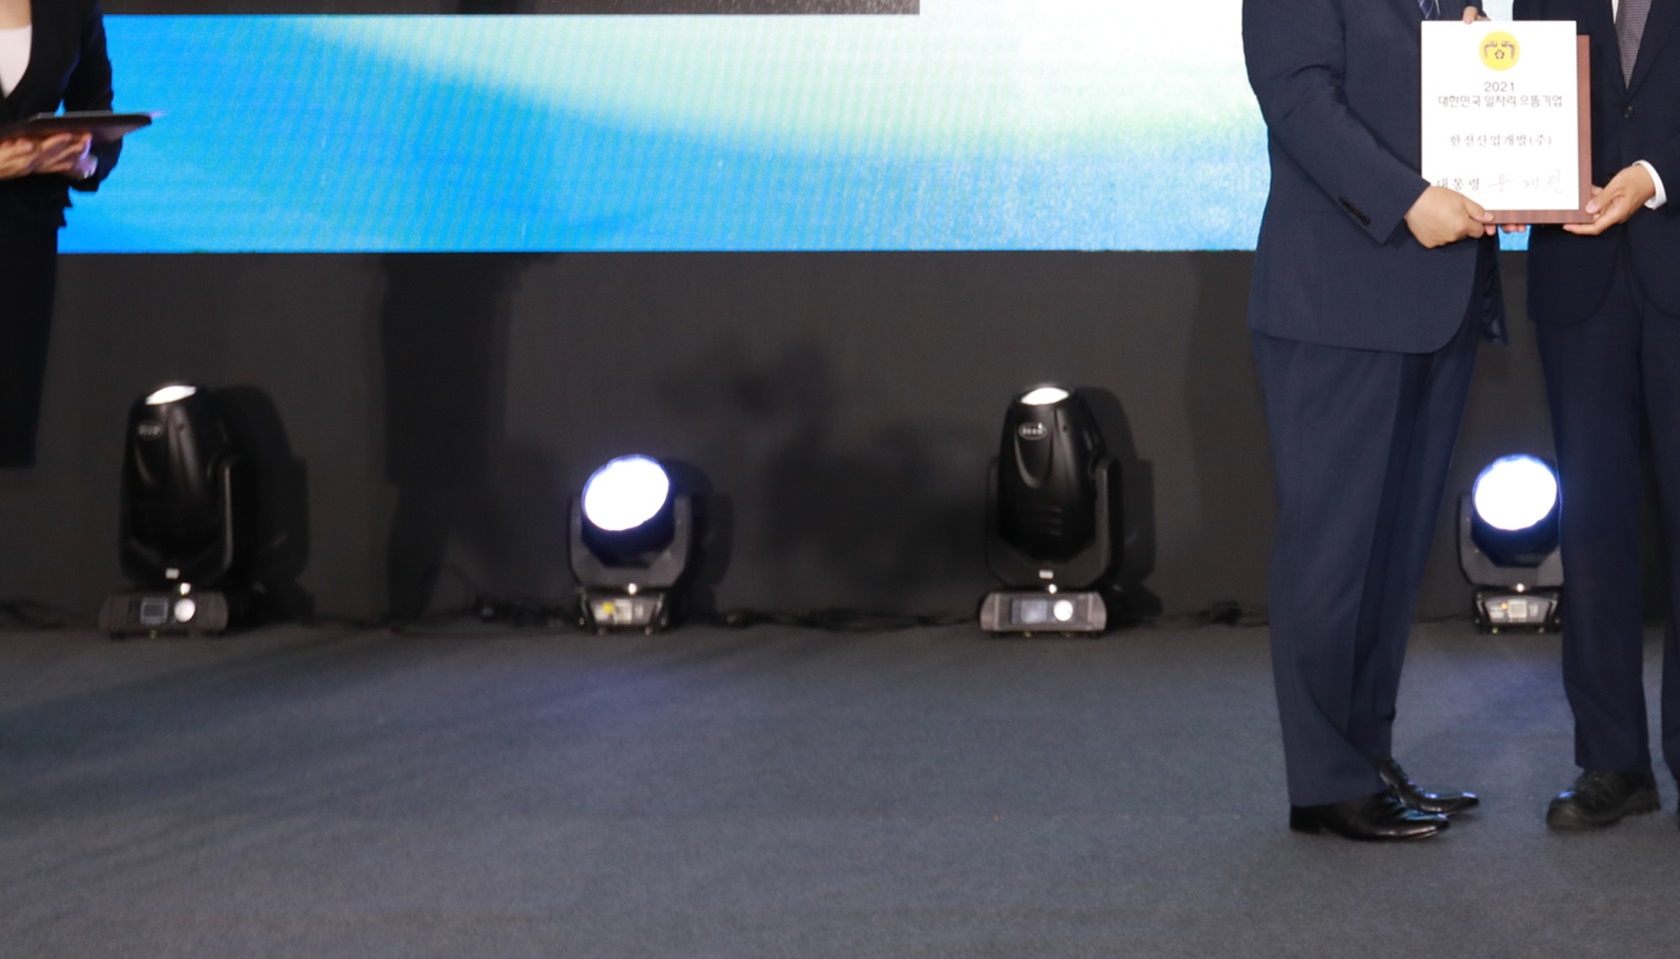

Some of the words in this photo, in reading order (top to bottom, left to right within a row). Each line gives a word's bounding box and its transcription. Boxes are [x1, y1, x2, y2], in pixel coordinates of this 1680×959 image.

[1483, 81, 1515, 93] 2021
[1437, 94, 1481, 108] 대한민국
[1483, 94, 1517, 108] 일자리
